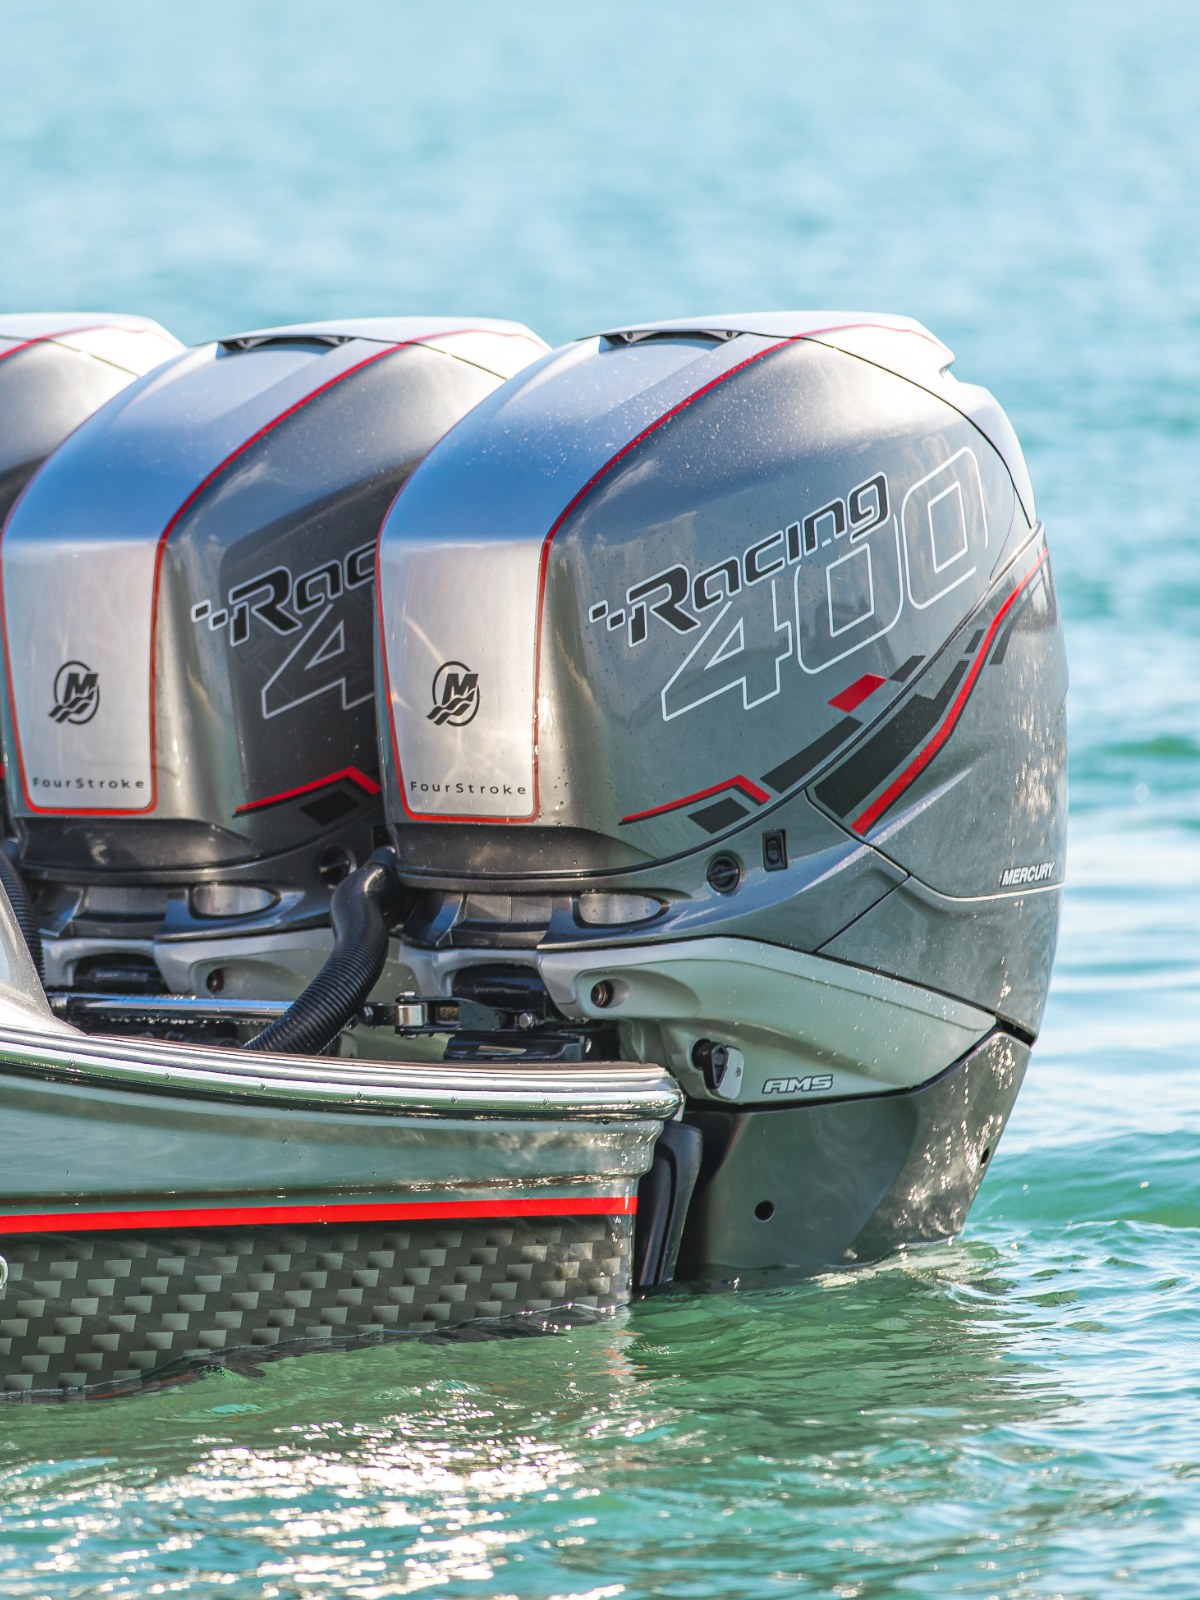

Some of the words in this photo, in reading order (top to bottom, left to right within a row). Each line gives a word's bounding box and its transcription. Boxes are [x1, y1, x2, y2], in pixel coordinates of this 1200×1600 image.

[626, 471, 893, 647] Racing
[661, 446, 989, 721] 400
[32, 777, 145, 789] FourStroke
[410, 781, 526, 795] FourStroke
[1001, 861, 1055, 886] MERCURY
[762, 1074, 833, 1094] AMS
